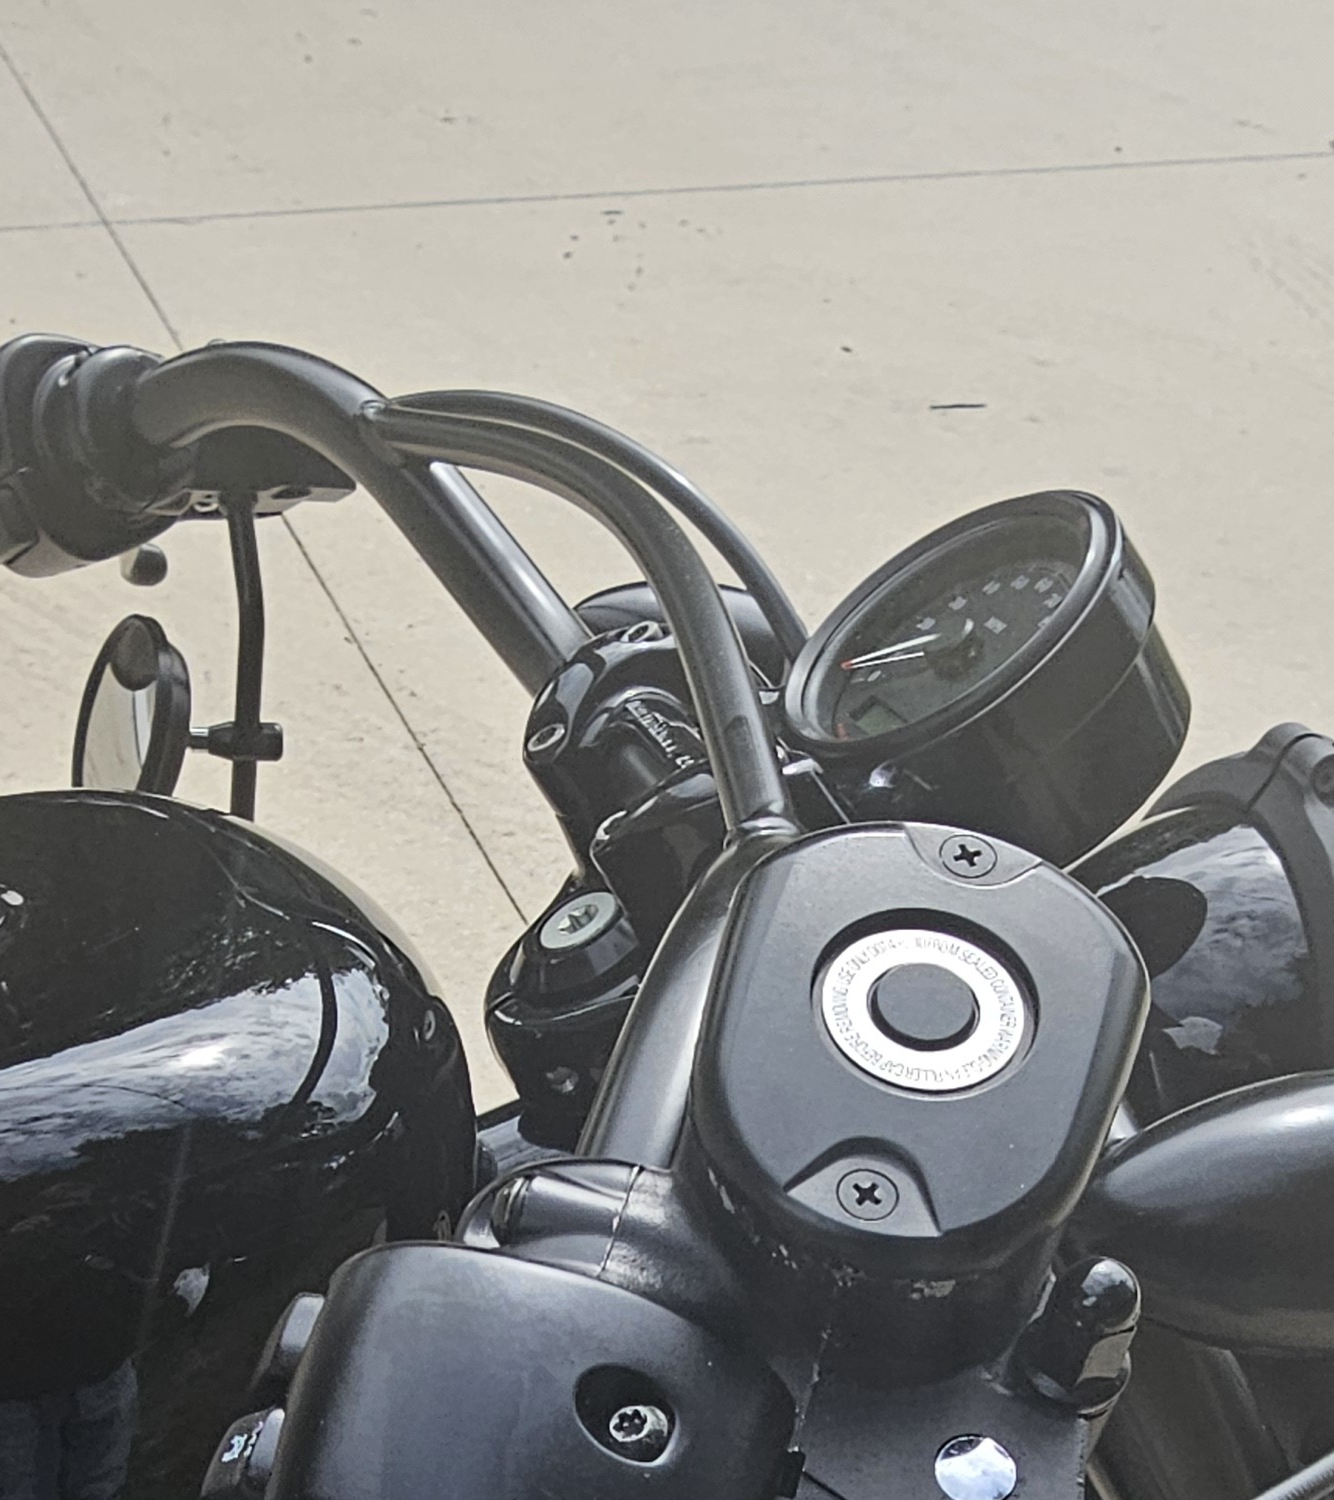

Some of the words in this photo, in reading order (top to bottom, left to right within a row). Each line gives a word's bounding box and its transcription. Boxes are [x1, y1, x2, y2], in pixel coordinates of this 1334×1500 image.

[957, 948, 999, 980] SEALED
[843, 1033, 884, 1067] BEFORE
[879, 1060, 906, 1078] CAP
